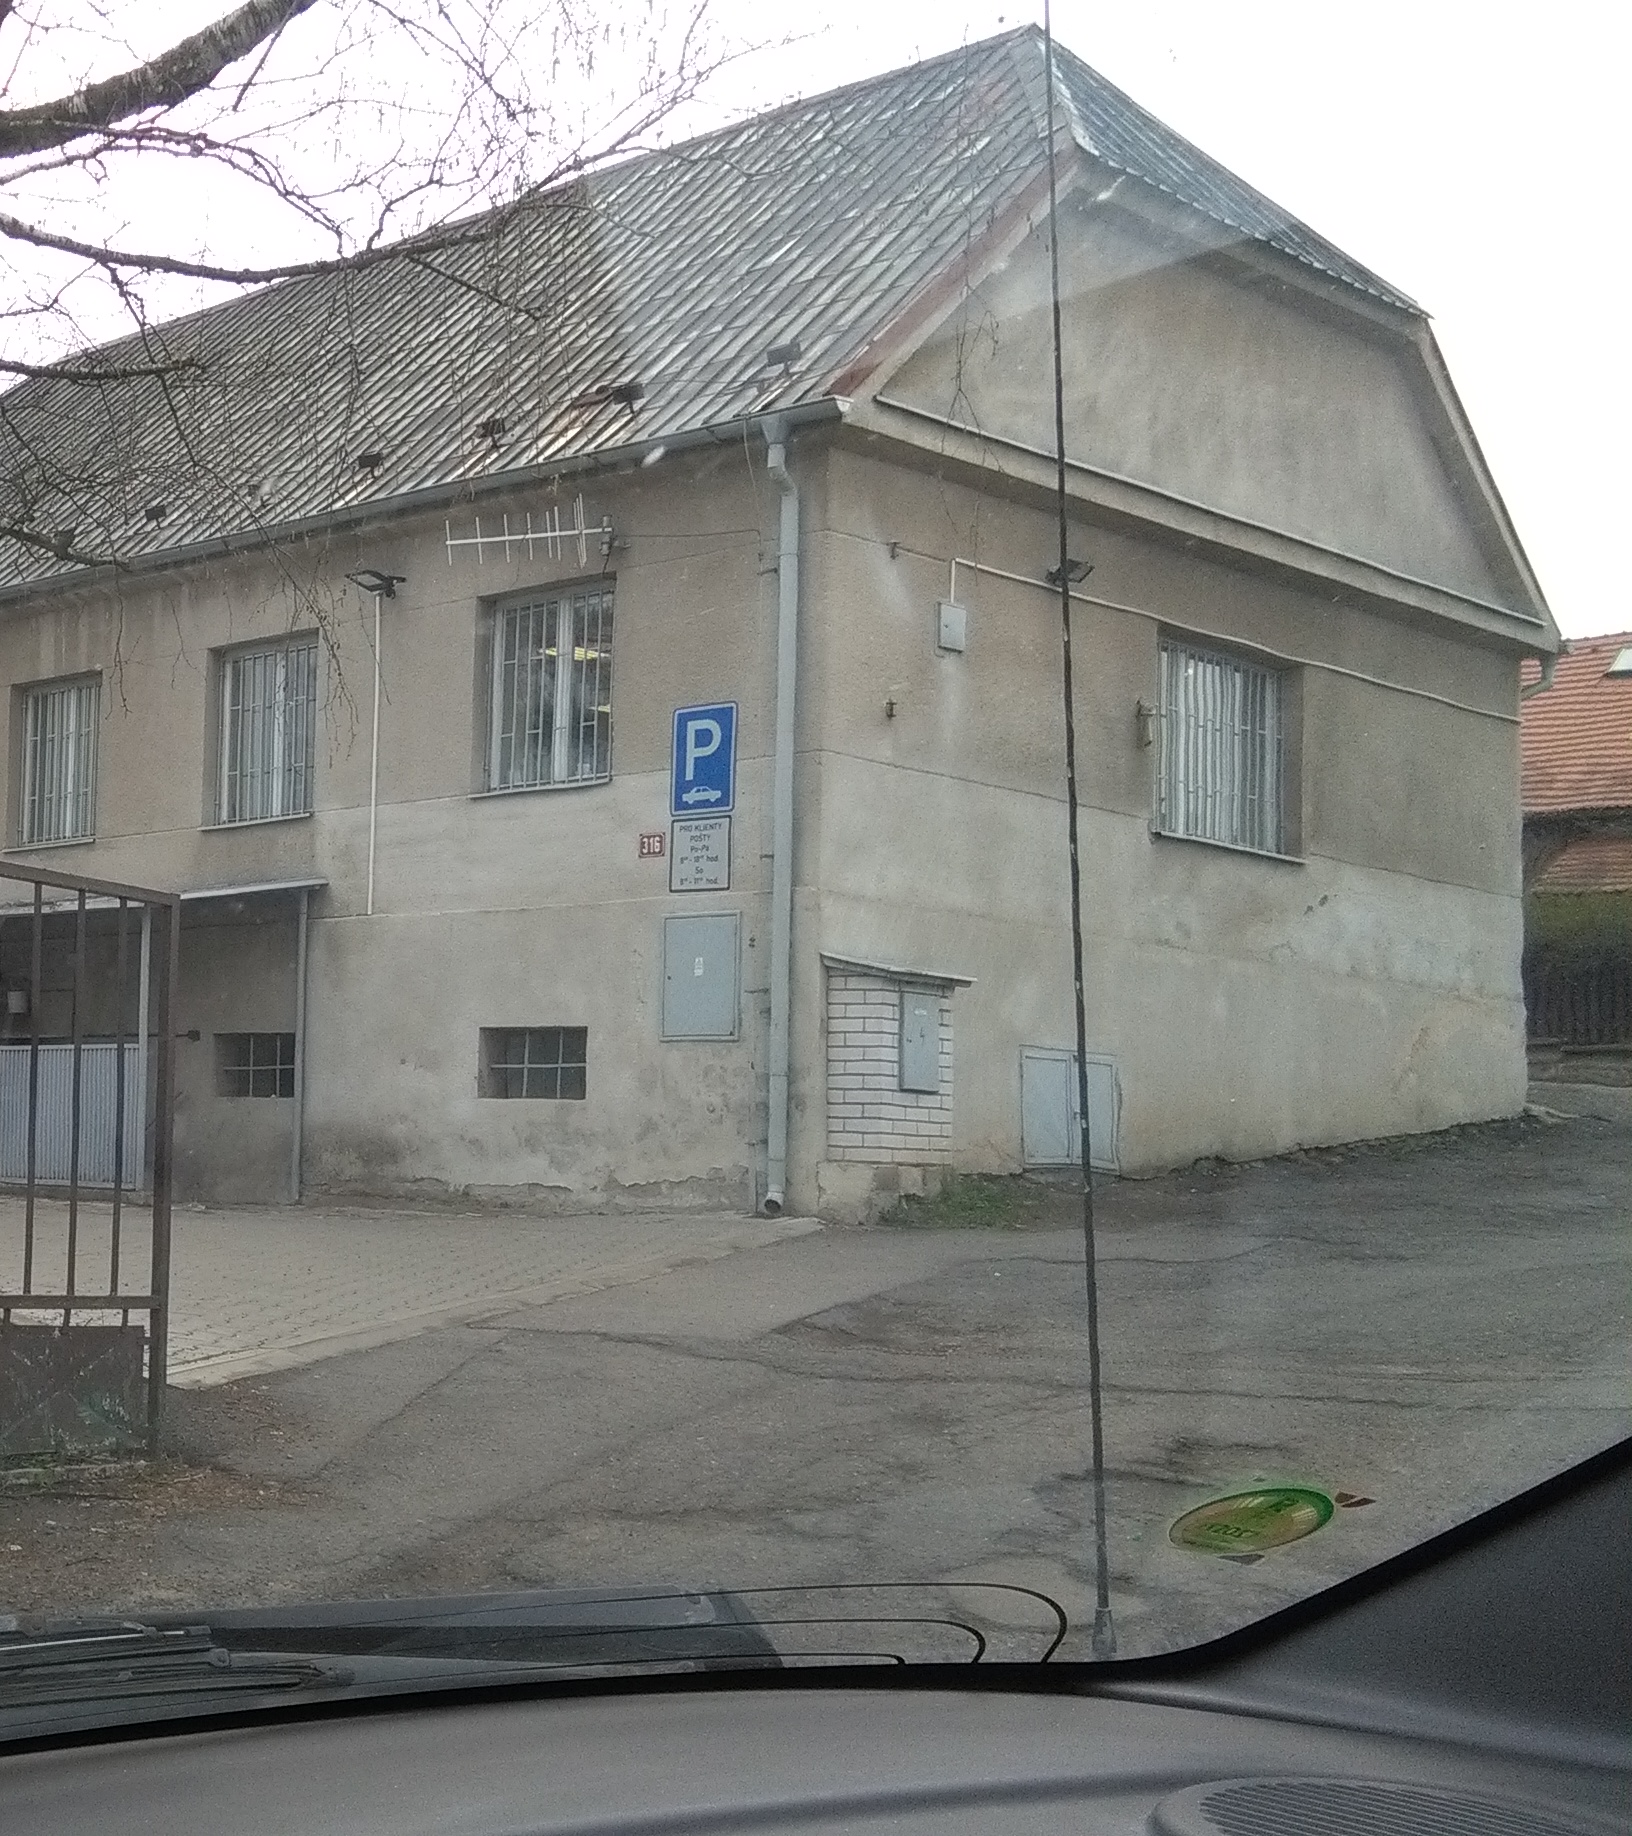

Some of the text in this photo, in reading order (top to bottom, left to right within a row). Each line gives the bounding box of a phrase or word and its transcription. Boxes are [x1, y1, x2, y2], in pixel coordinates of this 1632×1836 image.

[684, 718, 722, 781] P
[694, 822, 722, 831] KLIENTY
[642, 836, 661, 853] 316
